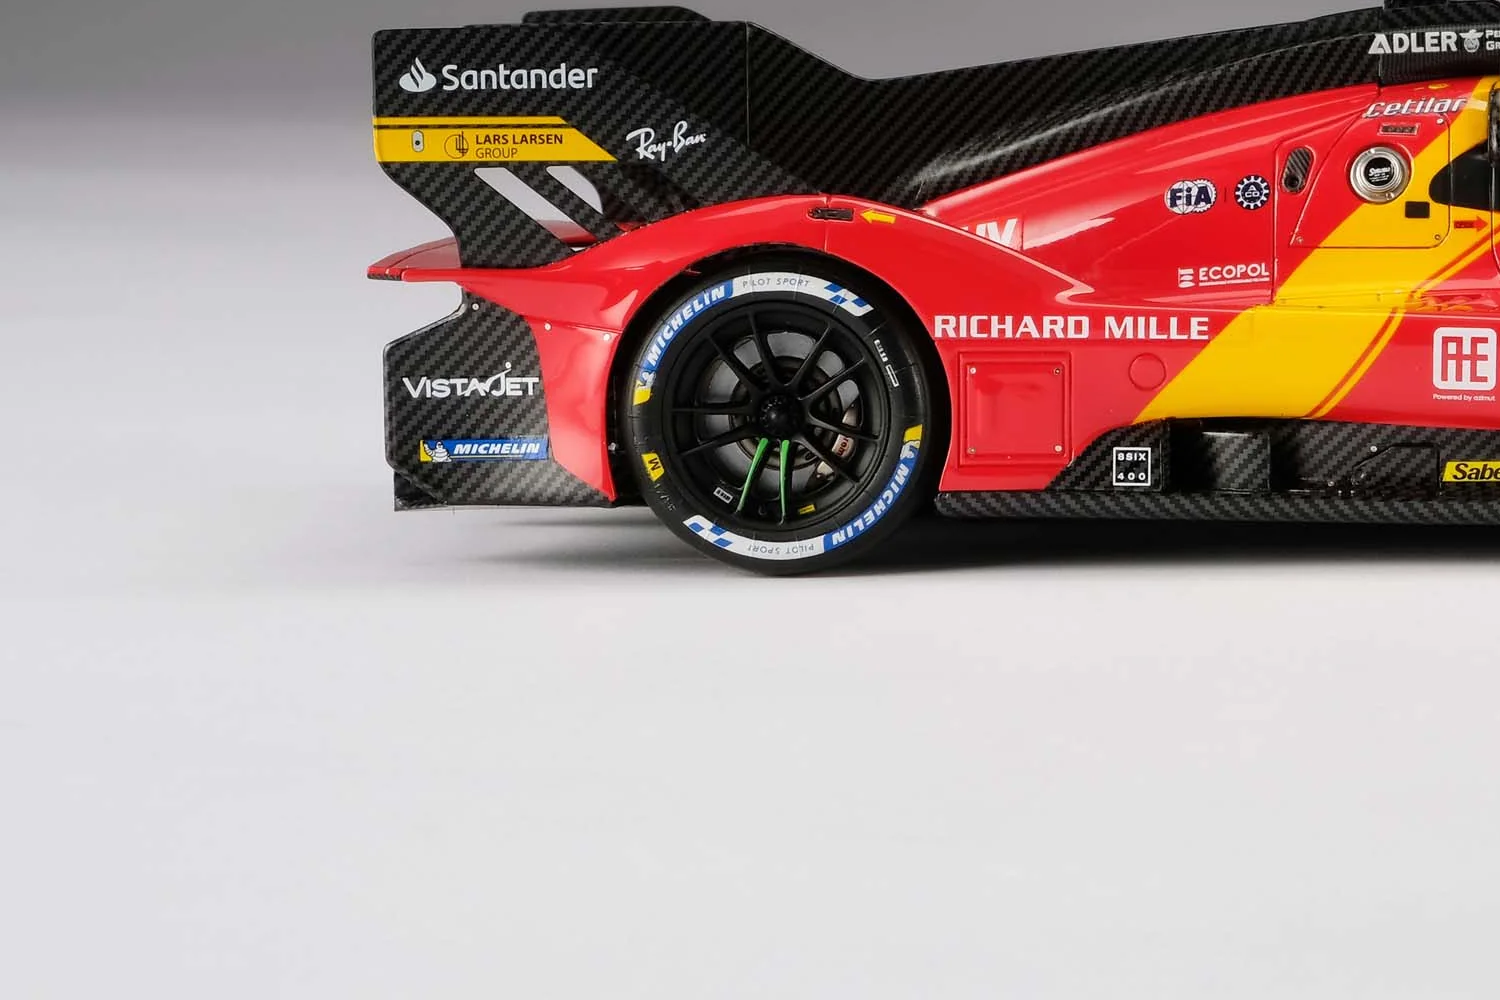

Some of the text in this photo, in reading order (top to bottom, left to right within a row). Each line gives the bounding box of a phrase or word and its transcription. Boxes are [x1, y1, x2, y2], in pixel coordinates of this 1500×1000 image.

[1368, 31, 1458, 54] ADLER
[441, 62, 599, 92] Santander
[475, 133, 563, 145] LARS LARSEN
[475, 147, 518, 159] GROUP
[776, 277, 811, 287] SPORT
[1198, 262, 1270, 281] ECOPOL
[647, 285, 725, 367] MICHELIN
[934, 315, 1210, 340] RICHARD MILLE
[453, 443, 541, 455] MICHELIN
[832, 463, 910, 546] MICHELIN
